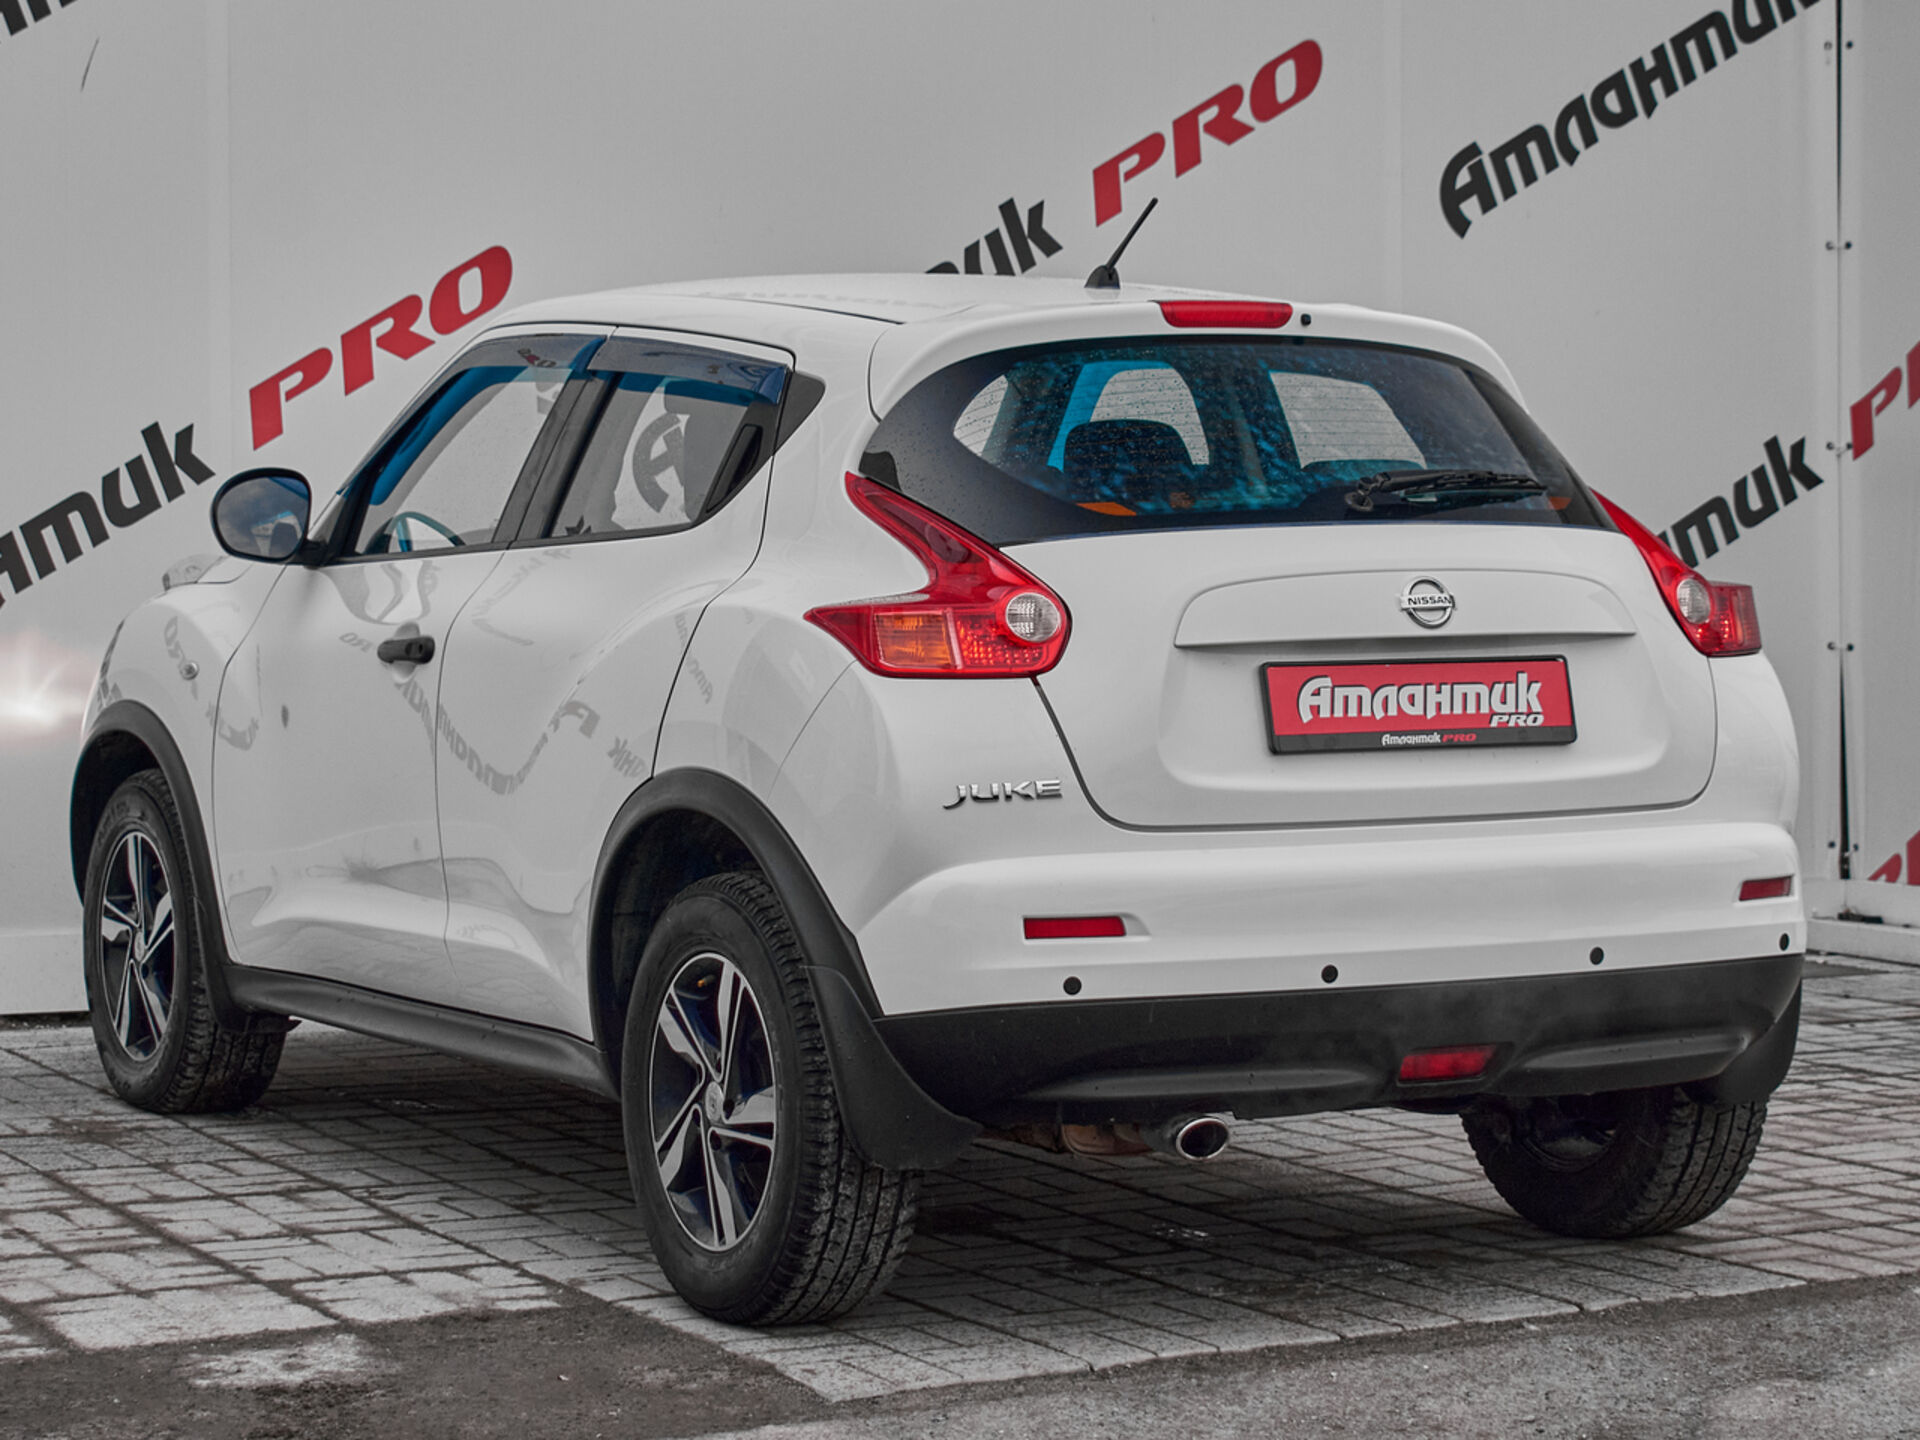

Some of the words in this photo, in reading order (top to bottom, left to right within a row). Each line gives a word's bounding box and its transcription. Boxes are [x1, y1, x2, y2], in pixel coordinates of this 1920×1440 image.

[1092, 38, 1323, 227] PRO
[249, 245, 514, 451] PRO
[1407, 595, 1452, 605] NISSAN
[1298, 671, 1543, 724] Атлантик
[1489, 713, 1545, 728] PRO
[1442, 733, 1477, 743] PRO
[942, 779, 1063, 811] JUKE
